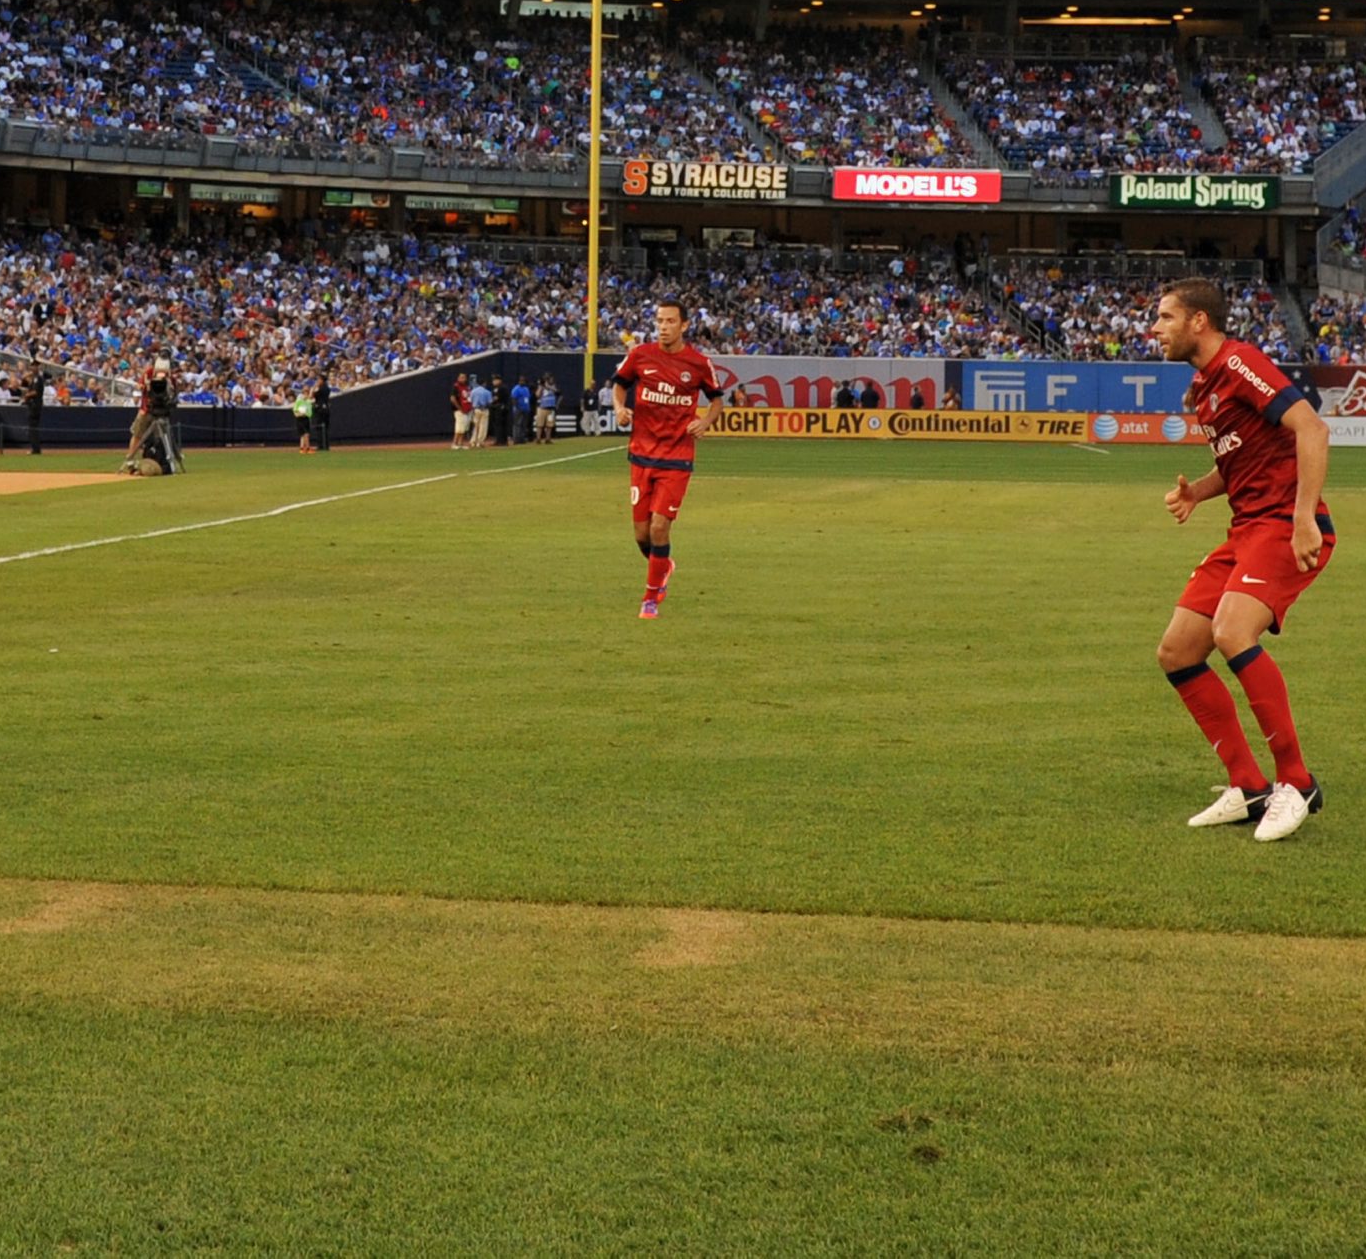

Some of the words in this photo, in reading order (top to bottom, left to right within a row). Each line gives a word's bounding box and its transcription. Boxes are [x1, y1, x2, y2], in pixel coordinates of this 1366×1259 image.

[651, 162, 788, 189] SYRACUSE
[855, 174, 977, 197] MODELL'S
[650, 186, 672, 197] NEW
[674, 187, 710, 198] YORK'S
[712, 188, 756, 199] COLLEGE
[759, 189, 787, 199] TEAM
[1119, 174, 1191, 204] Poland
[1195, 175, 1265, 209] Spring
[641, 388, 693, 406] Emirates
[658, 381, 675, 394] Fly
[714, 365, 935, 408] anon
[888, 412, 1010, 435] Continental
[1036, 420, 1085, 435] TIRE
